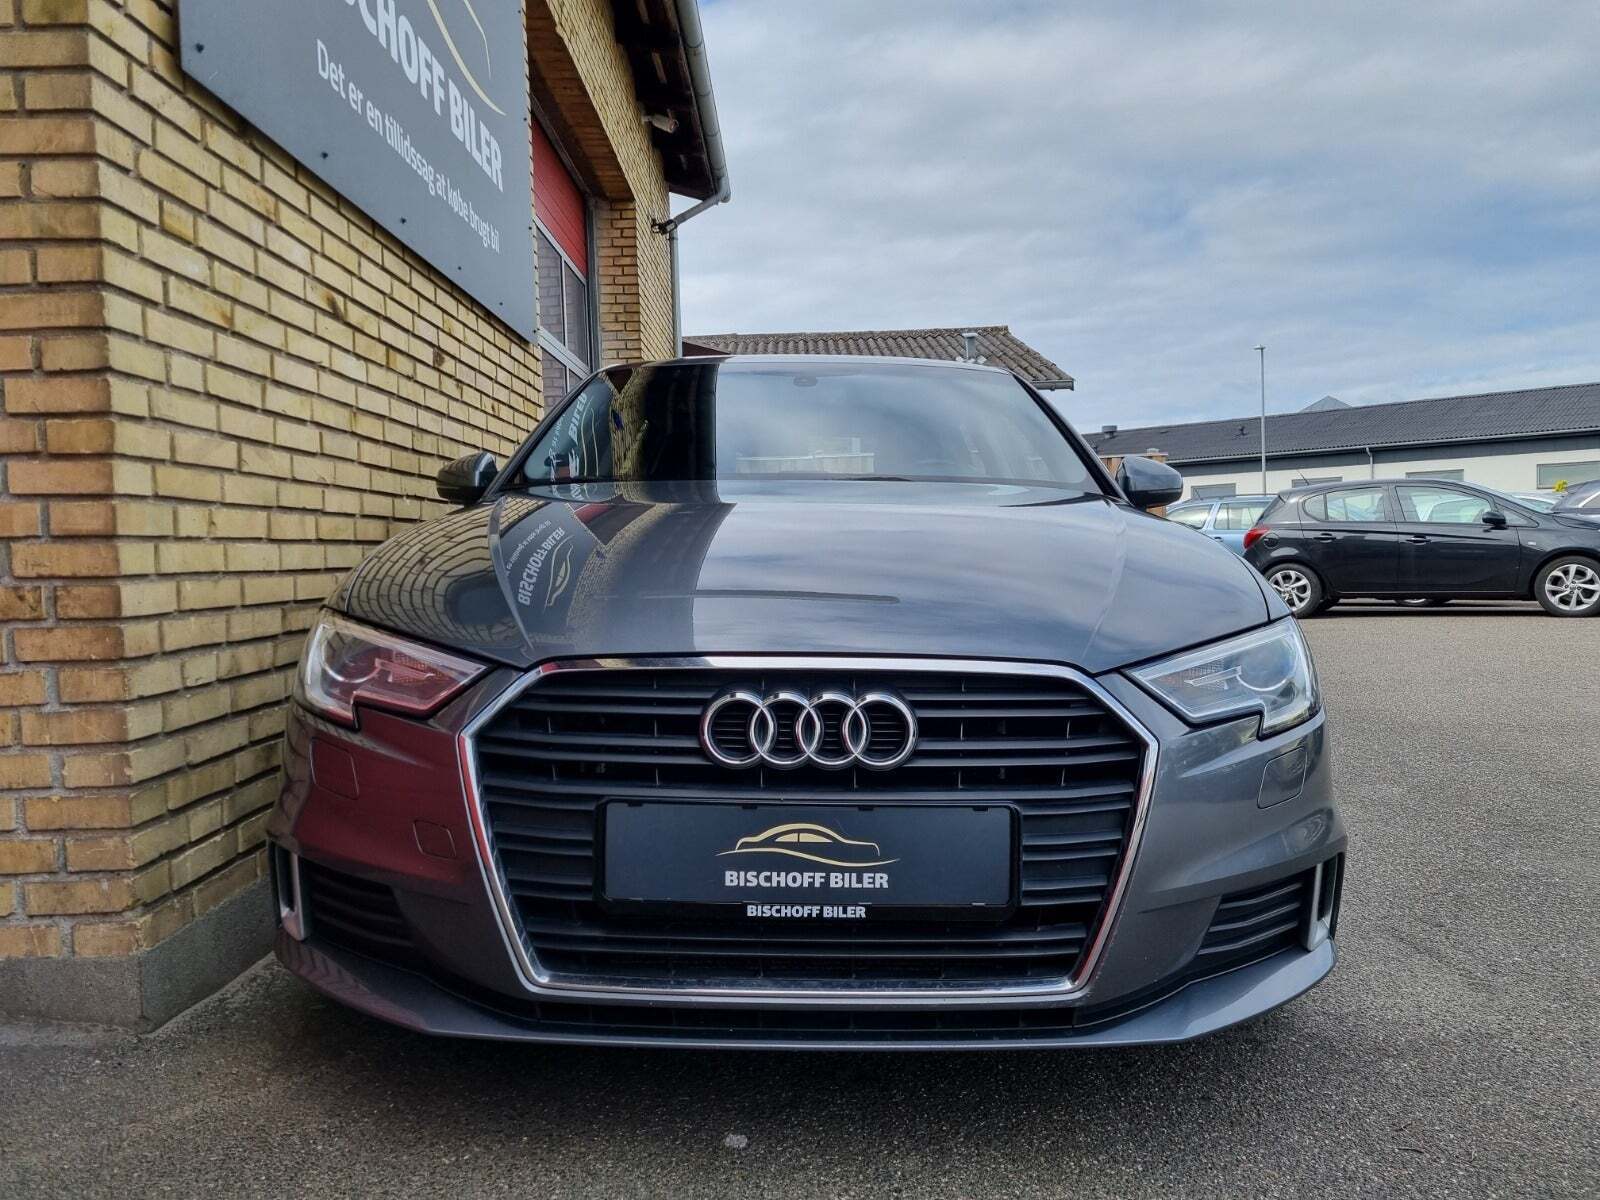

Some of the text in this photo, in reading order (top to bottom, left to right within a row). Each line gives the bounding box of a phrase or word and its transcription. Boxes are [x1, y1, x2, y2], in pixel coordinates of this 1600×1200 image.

[316, 38, 346, 99] Det
[349, 82, 363, 115] er
[366, 100, 383, 136] en
[385, 113, 435, 196] tillidssag
[436, 173, 446, 201] at
[447, 178, 468, 223] købe
[469, 201, 490, 248] brugt
[448, 78, 503, 193] BILER
[725, 871, 888, 889] BISCHOFF BILER
[747, 904, 866, 919] BISCHOFF BILER
